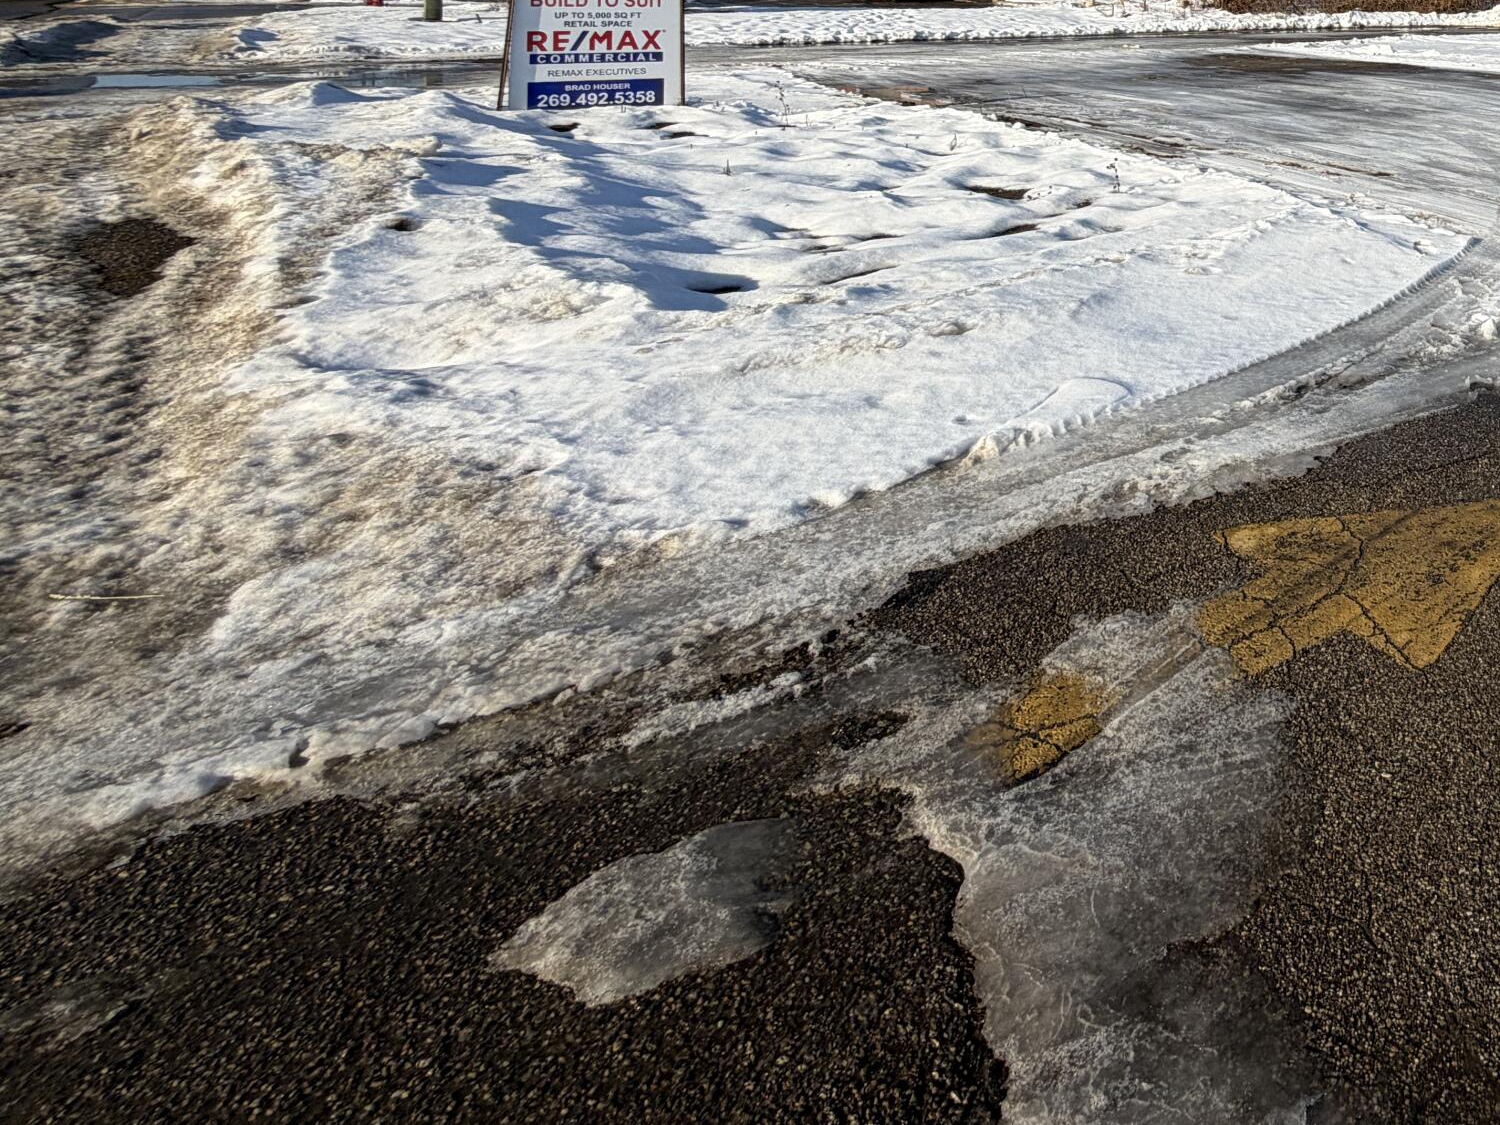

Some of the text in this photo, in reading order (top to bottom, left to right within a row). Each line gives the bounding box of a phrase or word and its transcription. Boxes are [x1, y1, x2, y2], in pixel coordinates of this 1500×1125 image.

[587, 11, 612, 20] 5,000
[563, 20, 633, 28] RETAIL SPACE
[527, 30, 662, 52] RE/MAX
[537, 52, 656, 64] COMMERCIAL
[547, 67, 647, 77] REMAX EXECUTIVES
[564, 83, 631, 92] BRAD HOUSER
[537, 91, 656, 108] 269.492.5358
